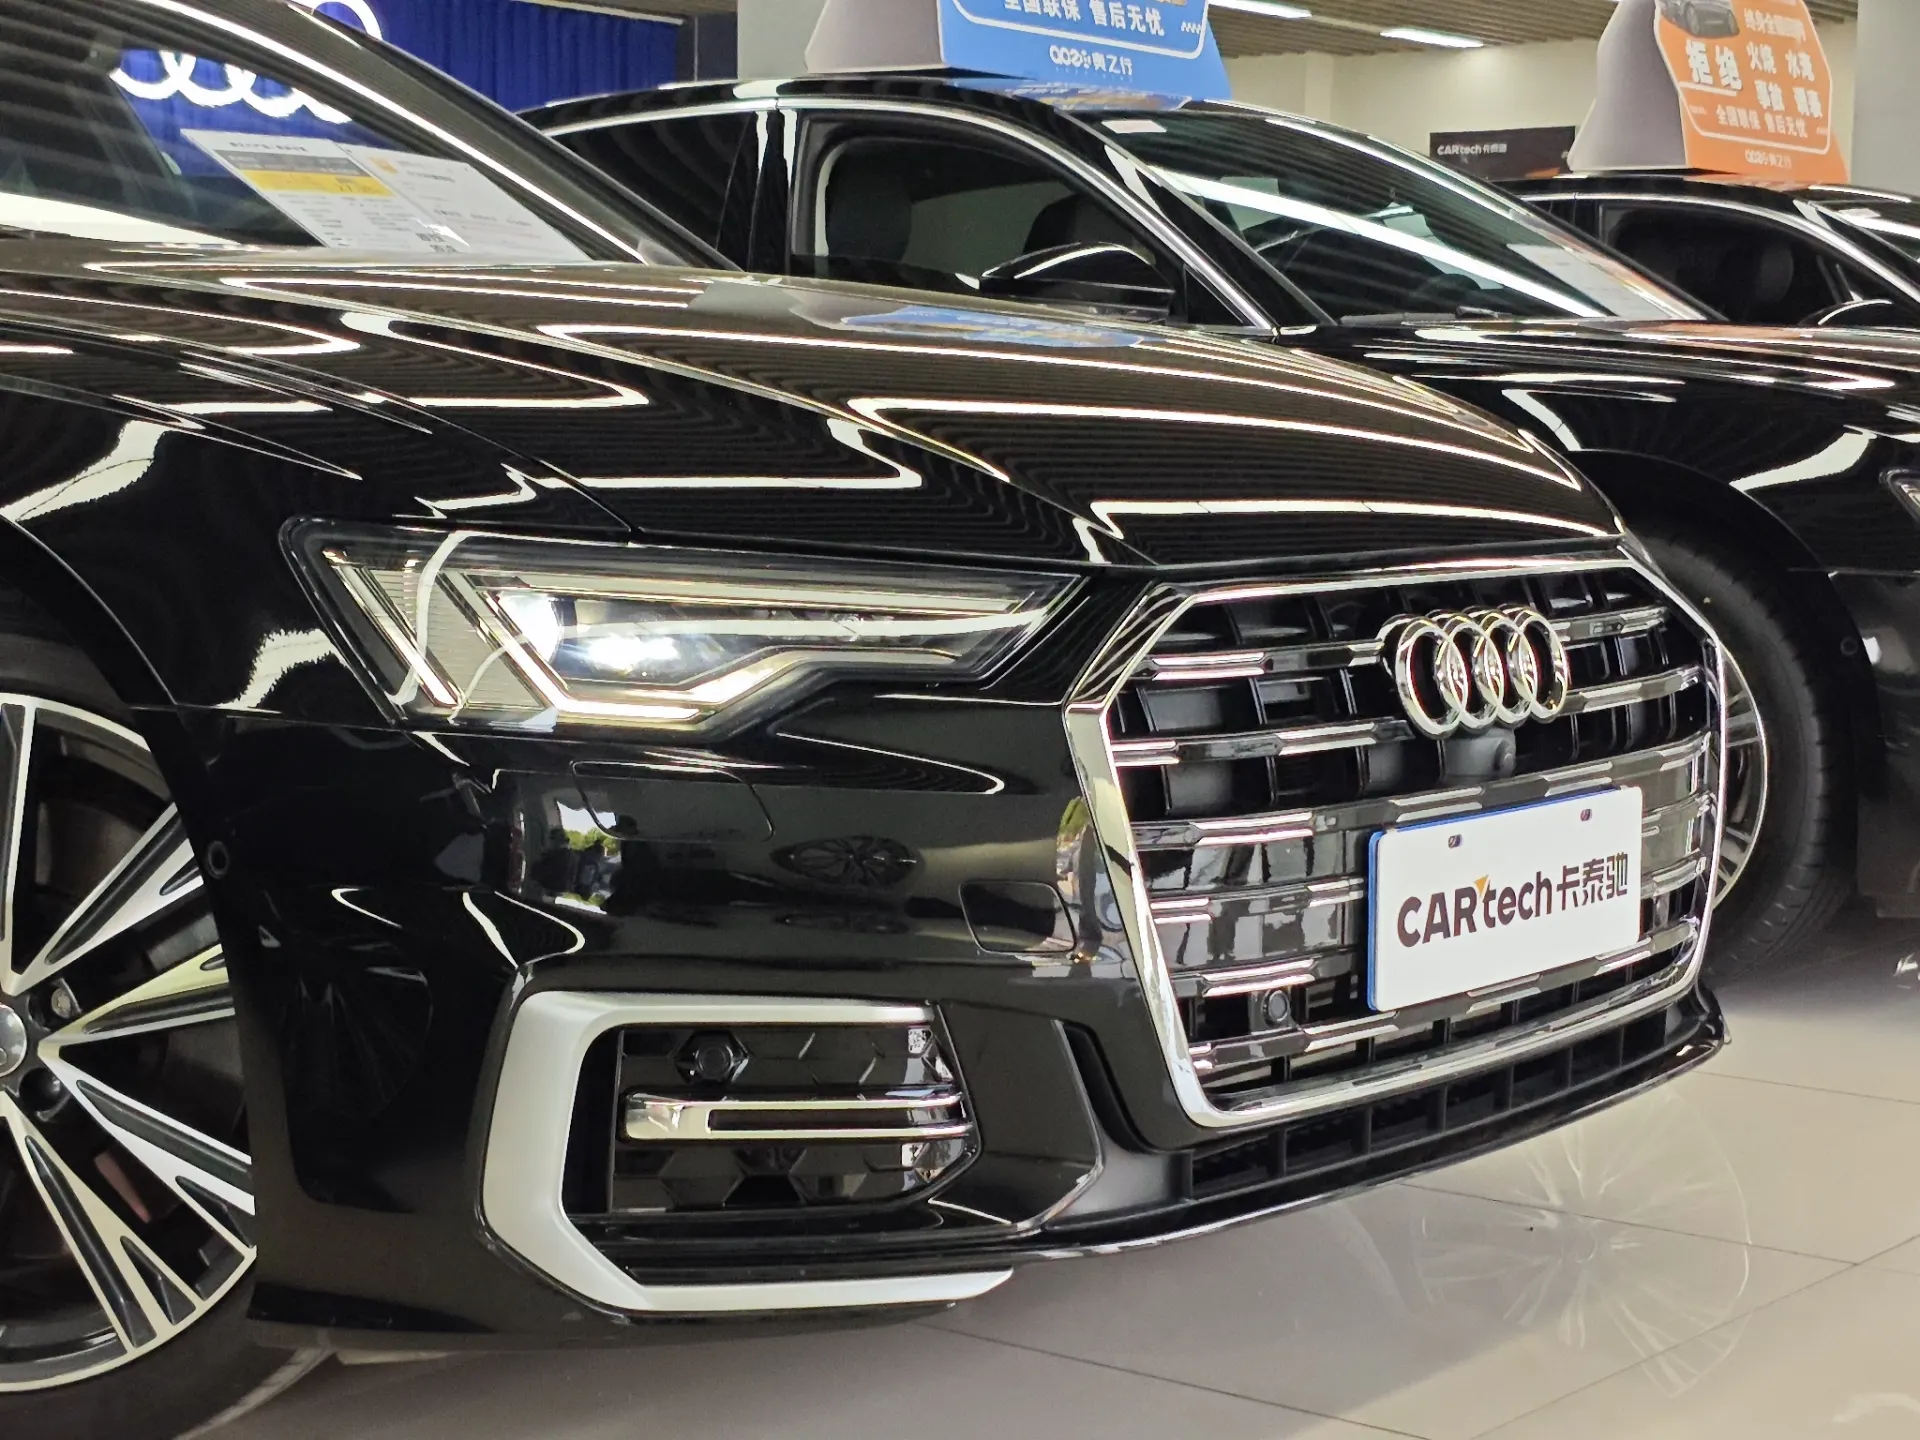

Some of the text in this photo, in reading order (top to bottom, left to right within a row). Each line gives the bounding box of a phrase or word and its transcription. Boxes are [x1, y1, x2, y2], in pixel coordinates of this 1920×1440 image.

[1089, 0, 1165, 36] 售后无忧
[1685, 39, 1743, 91] 拒绝
[1397, 852, 1628, 948] CARtech 卡泰驰
